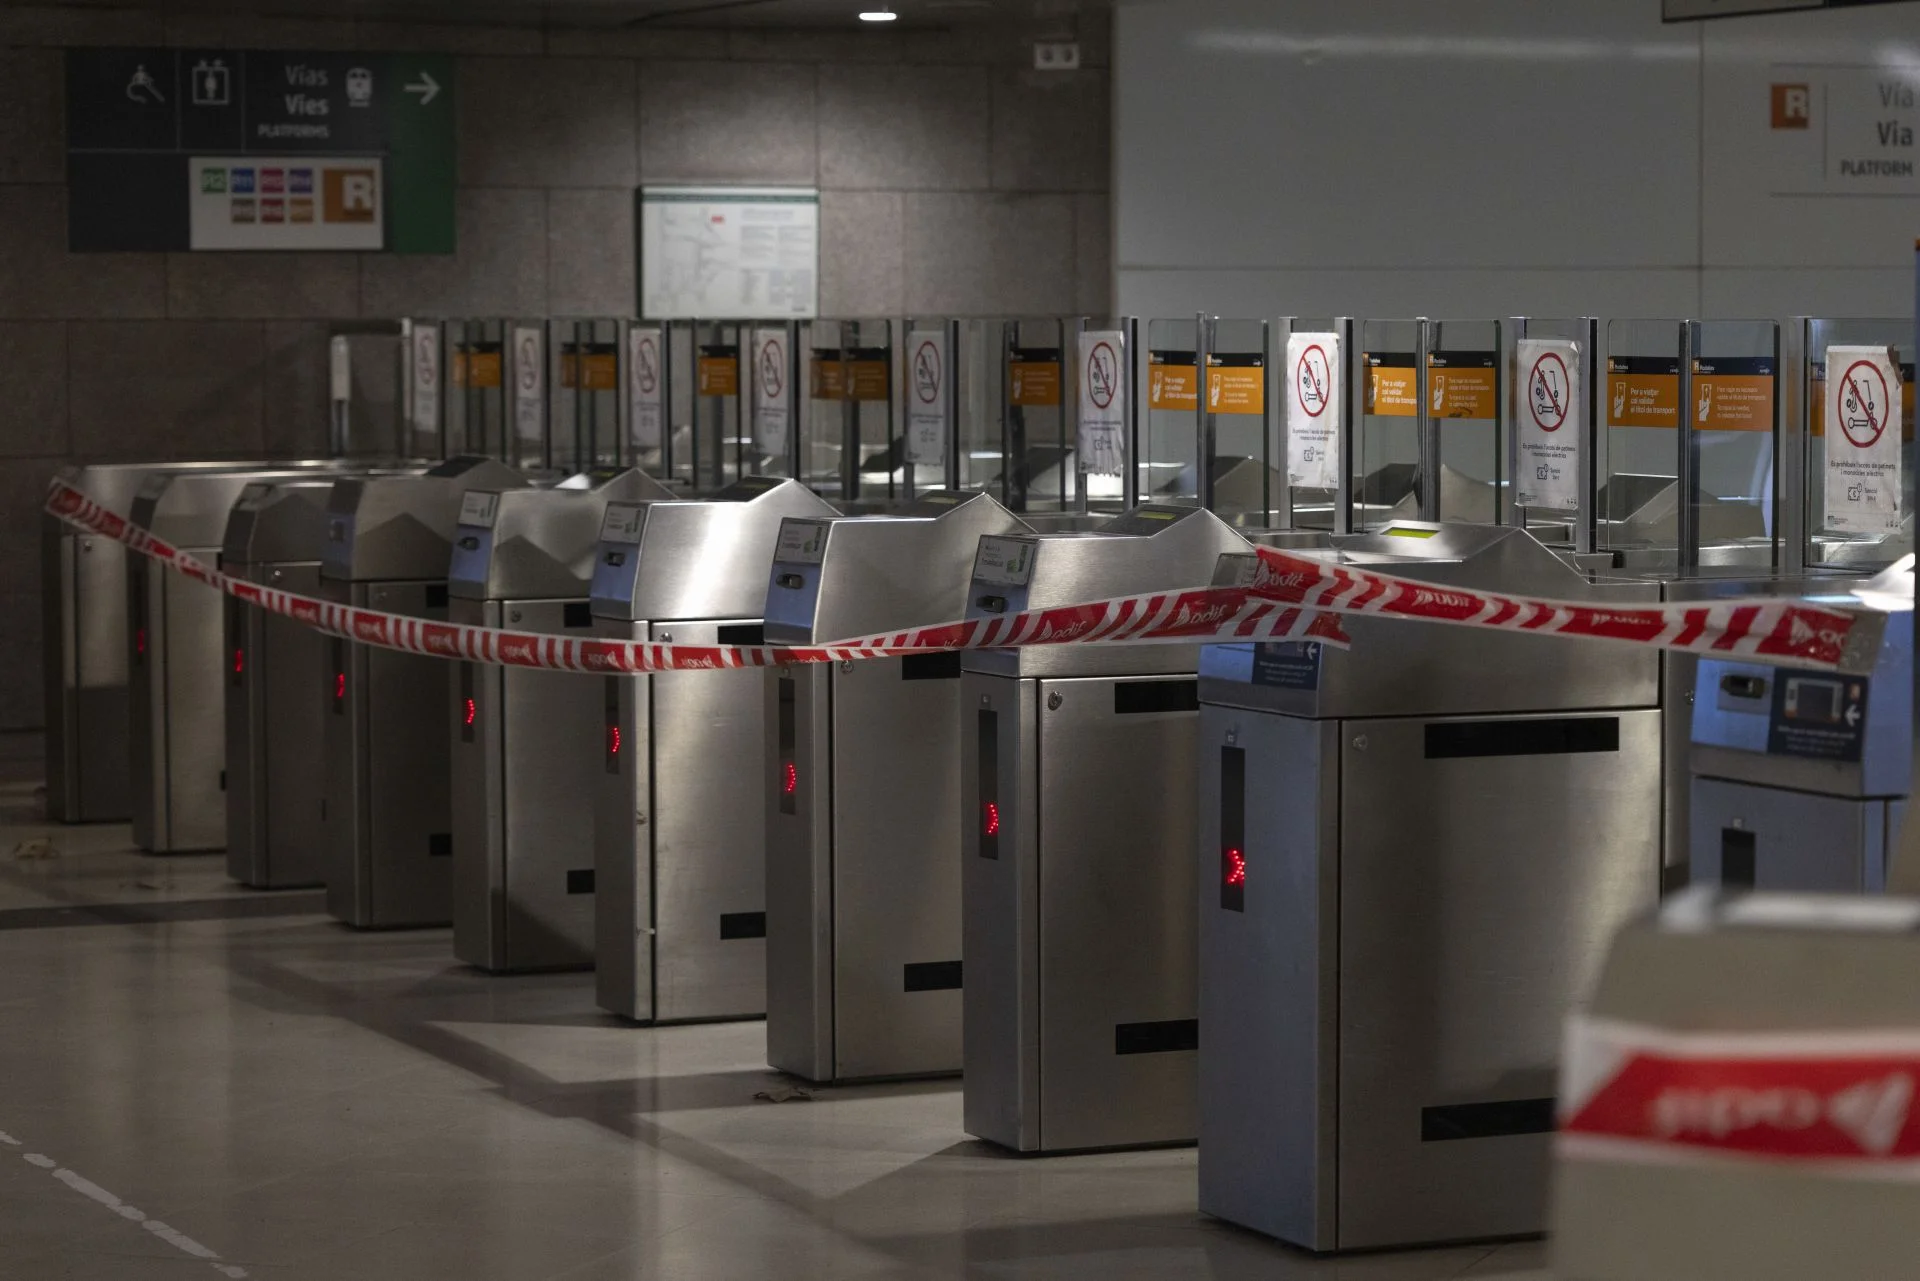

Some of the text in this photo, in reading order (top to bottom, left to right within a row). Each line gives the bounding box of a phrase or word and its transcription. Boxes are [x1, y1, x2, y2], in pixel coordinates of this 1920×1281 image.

[284, 93, 330, 116] Vies
[1785, 88, 1808, 118] R
[257, 124, 331, 138] PLATFORMS
[1877, 120, 1914, 147] Via
[1841, 159, 1914, 177] PLATFORM
[341, 174, 373, 210] R
